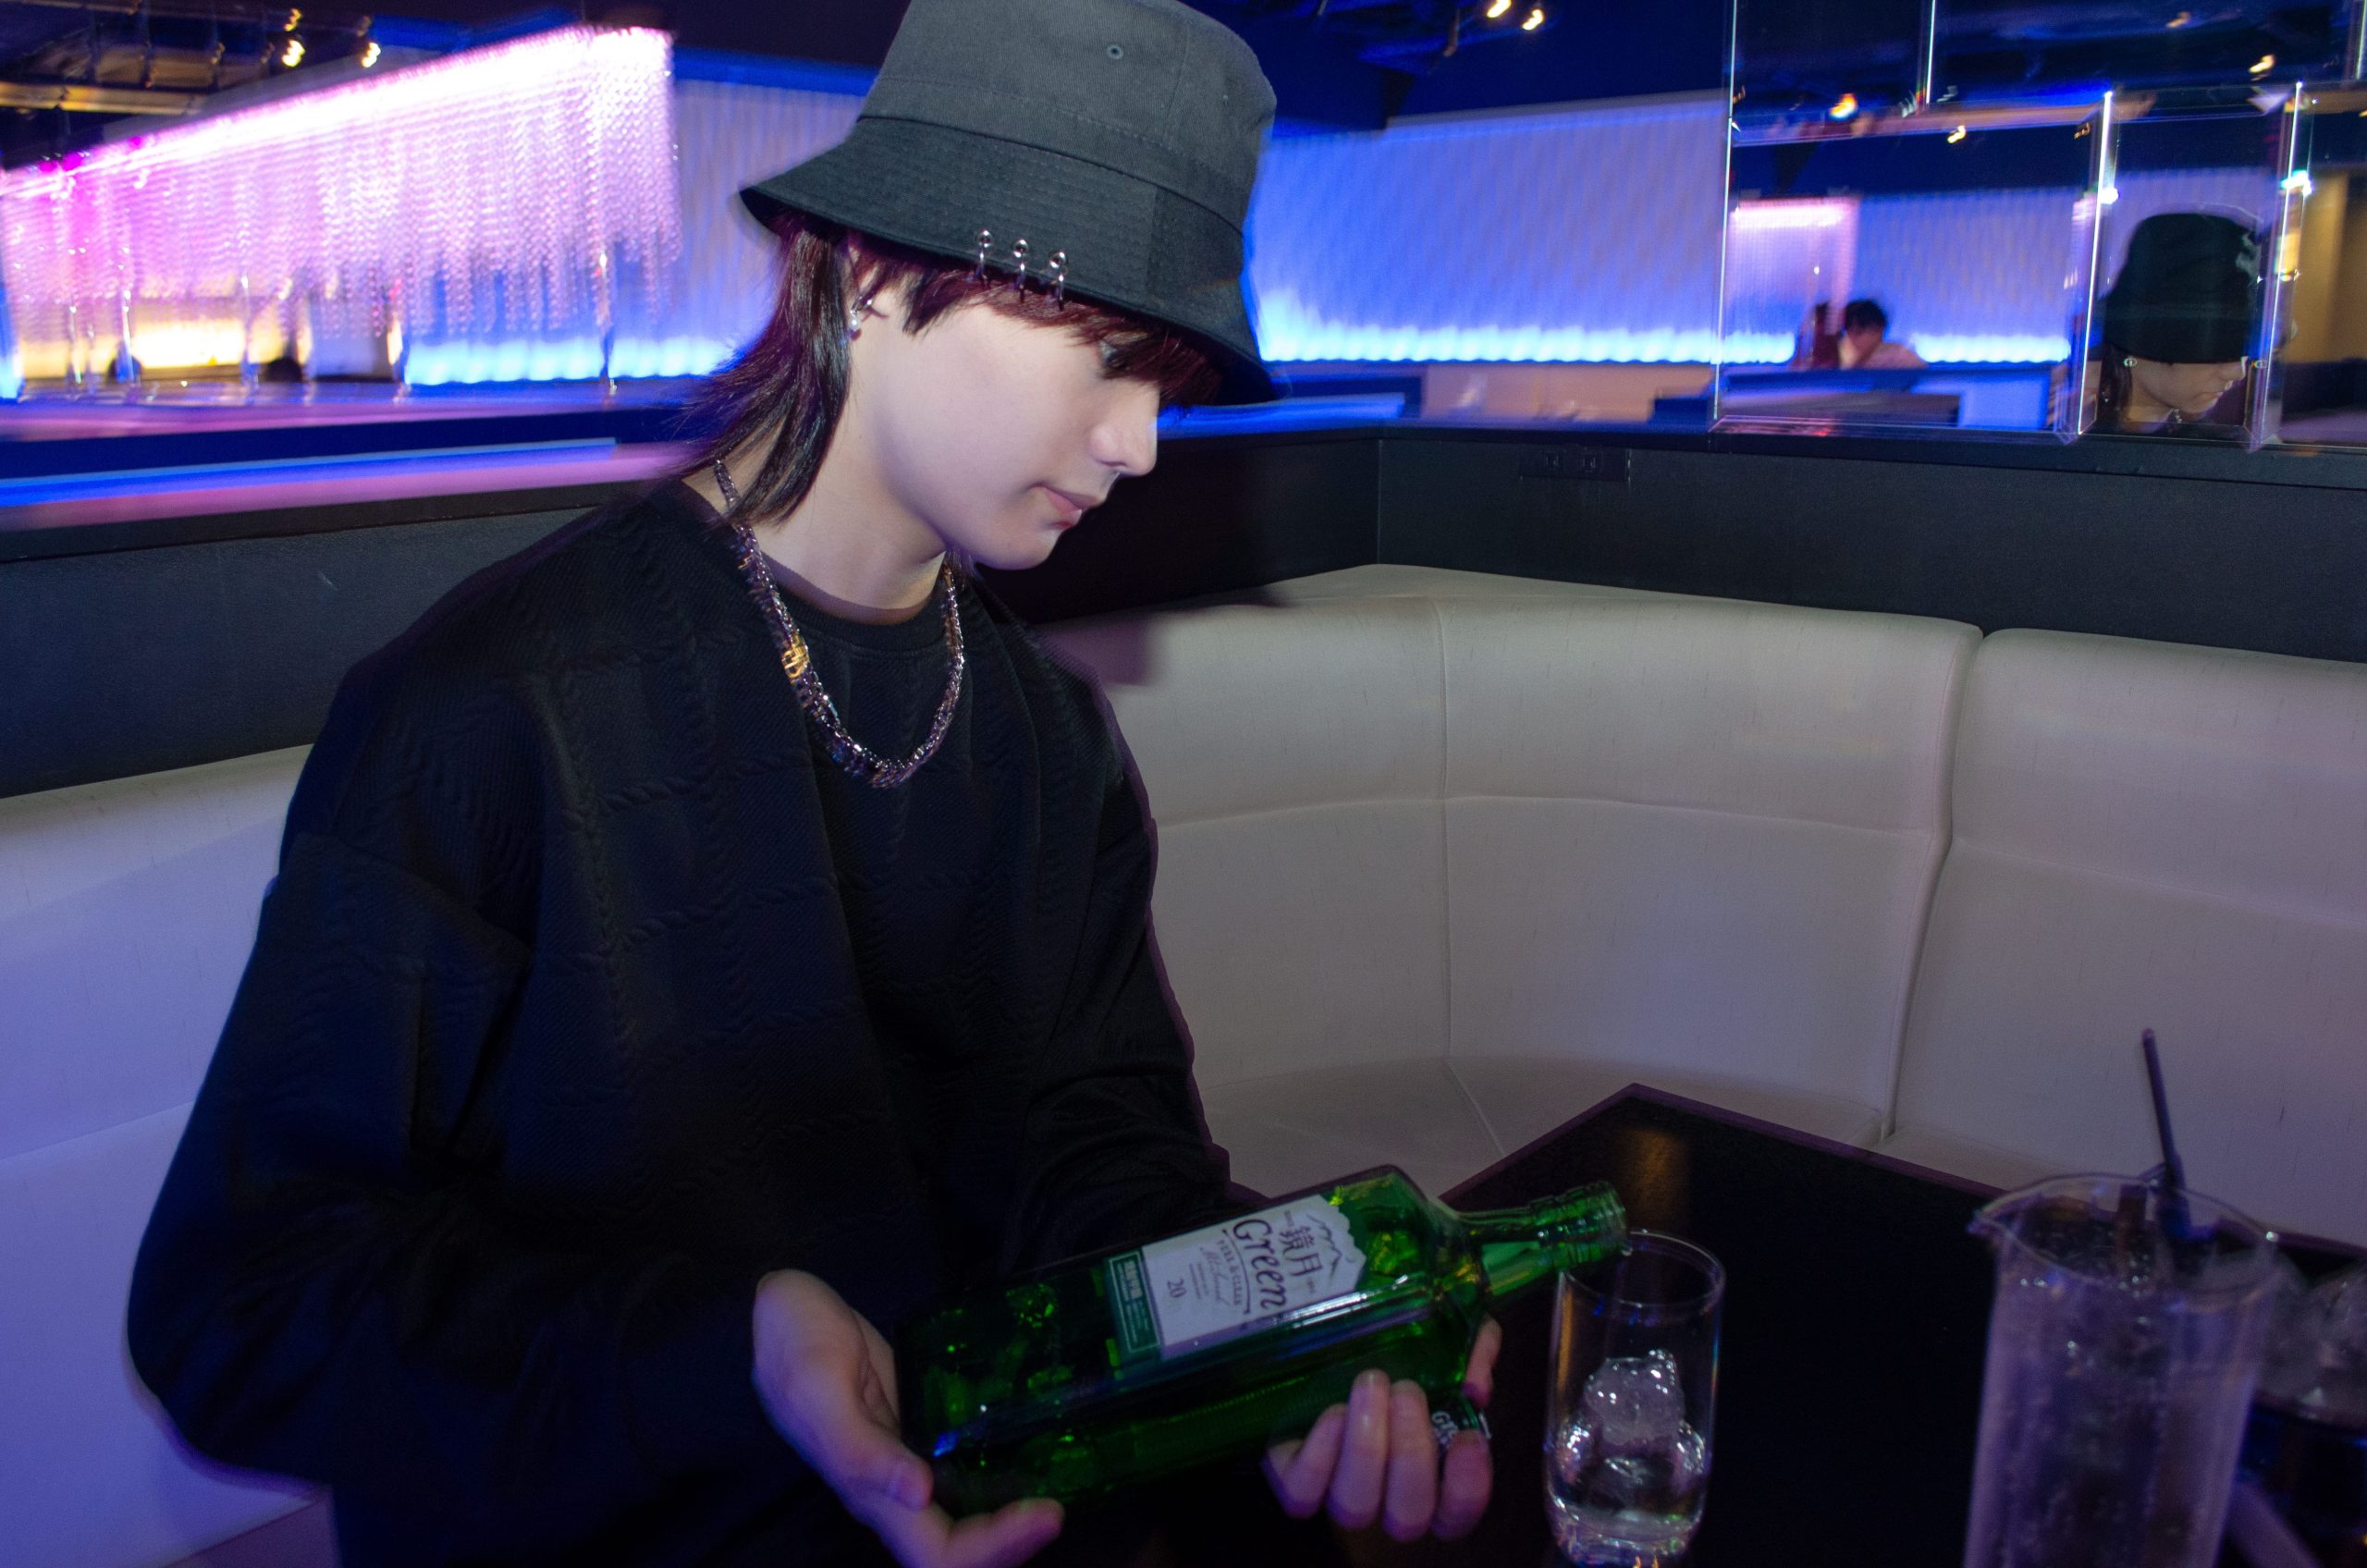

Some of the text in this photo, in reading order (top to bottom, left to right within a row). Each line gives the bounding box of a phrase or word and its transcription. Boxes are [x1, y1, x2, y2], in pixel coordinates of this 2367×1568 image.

[1233, 1219, 1287, 1309] Green
[1280, 1226, 1322, 1277] 鏡月
[1167, 1279, 1187, 1298] 20
